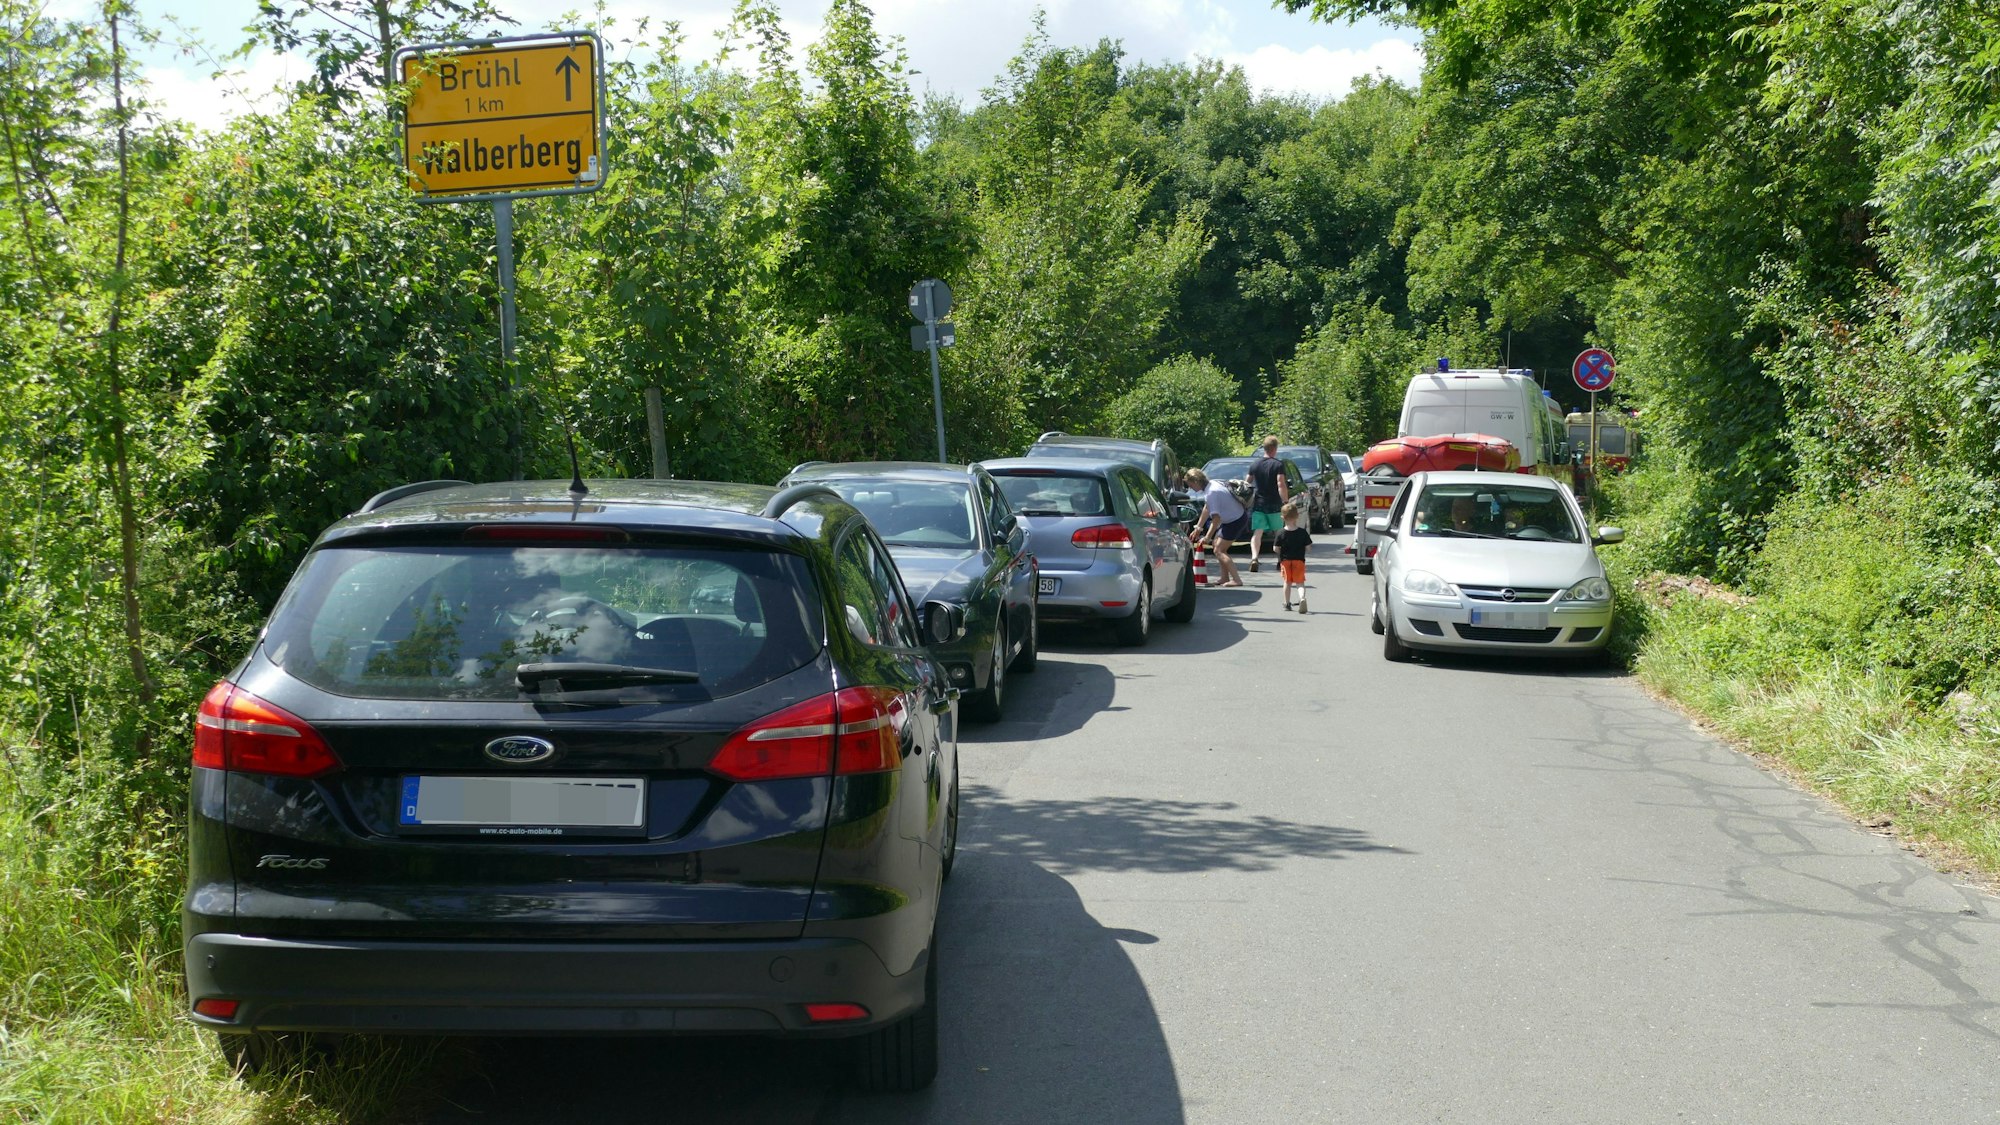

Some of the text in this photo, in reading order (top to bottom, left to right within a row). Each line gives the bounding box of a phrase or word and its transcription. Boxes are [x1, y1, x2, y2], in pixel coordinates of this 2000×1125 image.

[440, 58, 521, 91] Brühl
[464, 96, 504, 113] 1 km
[422, 134, 581, 174] Walberberg
[1041, 580, 1053, 591] 58
[500, 740, 538, 757] Ford
[406, 805, 416, 817] D
[479, 827, 563, 835] www.cc-auto-mobile.de
